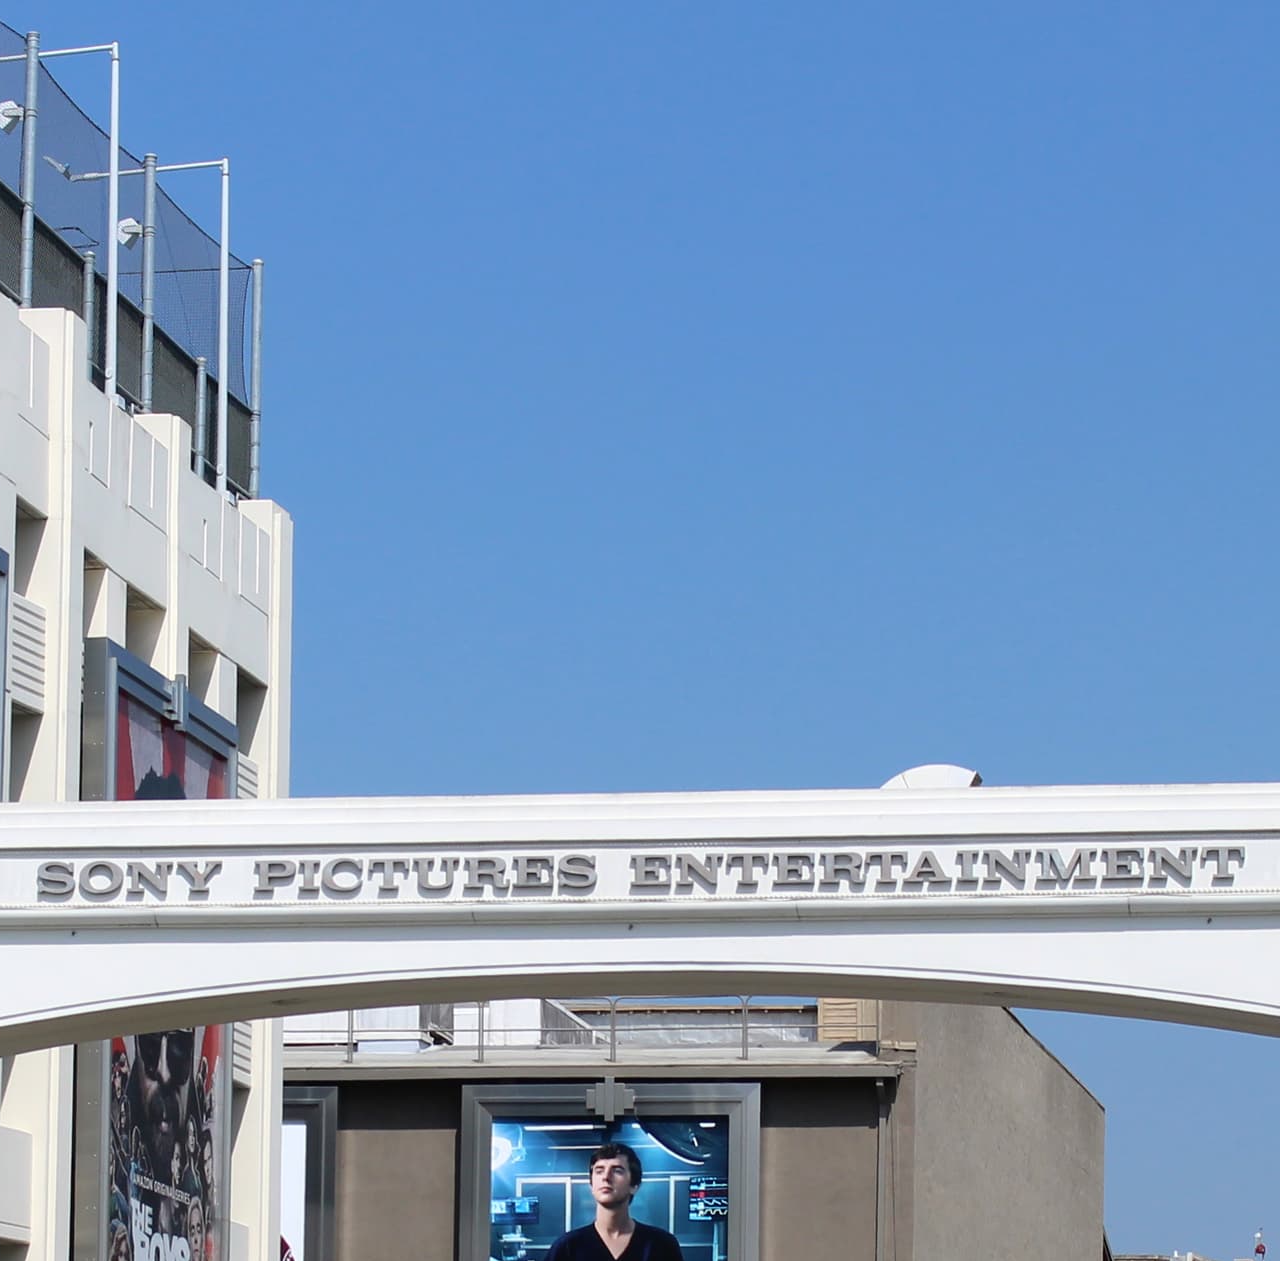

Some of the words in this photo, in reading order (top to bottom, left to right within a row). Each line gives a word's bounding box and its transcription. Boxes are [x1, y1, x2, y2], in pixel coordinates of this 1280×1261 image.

[37, 859, 222, 897] SONY
[253, 854, 598, 896] PICTURES
[630, 846, 1246, 890] ENTERTAINMENT
[131, 1198, 153, 1236] THE
